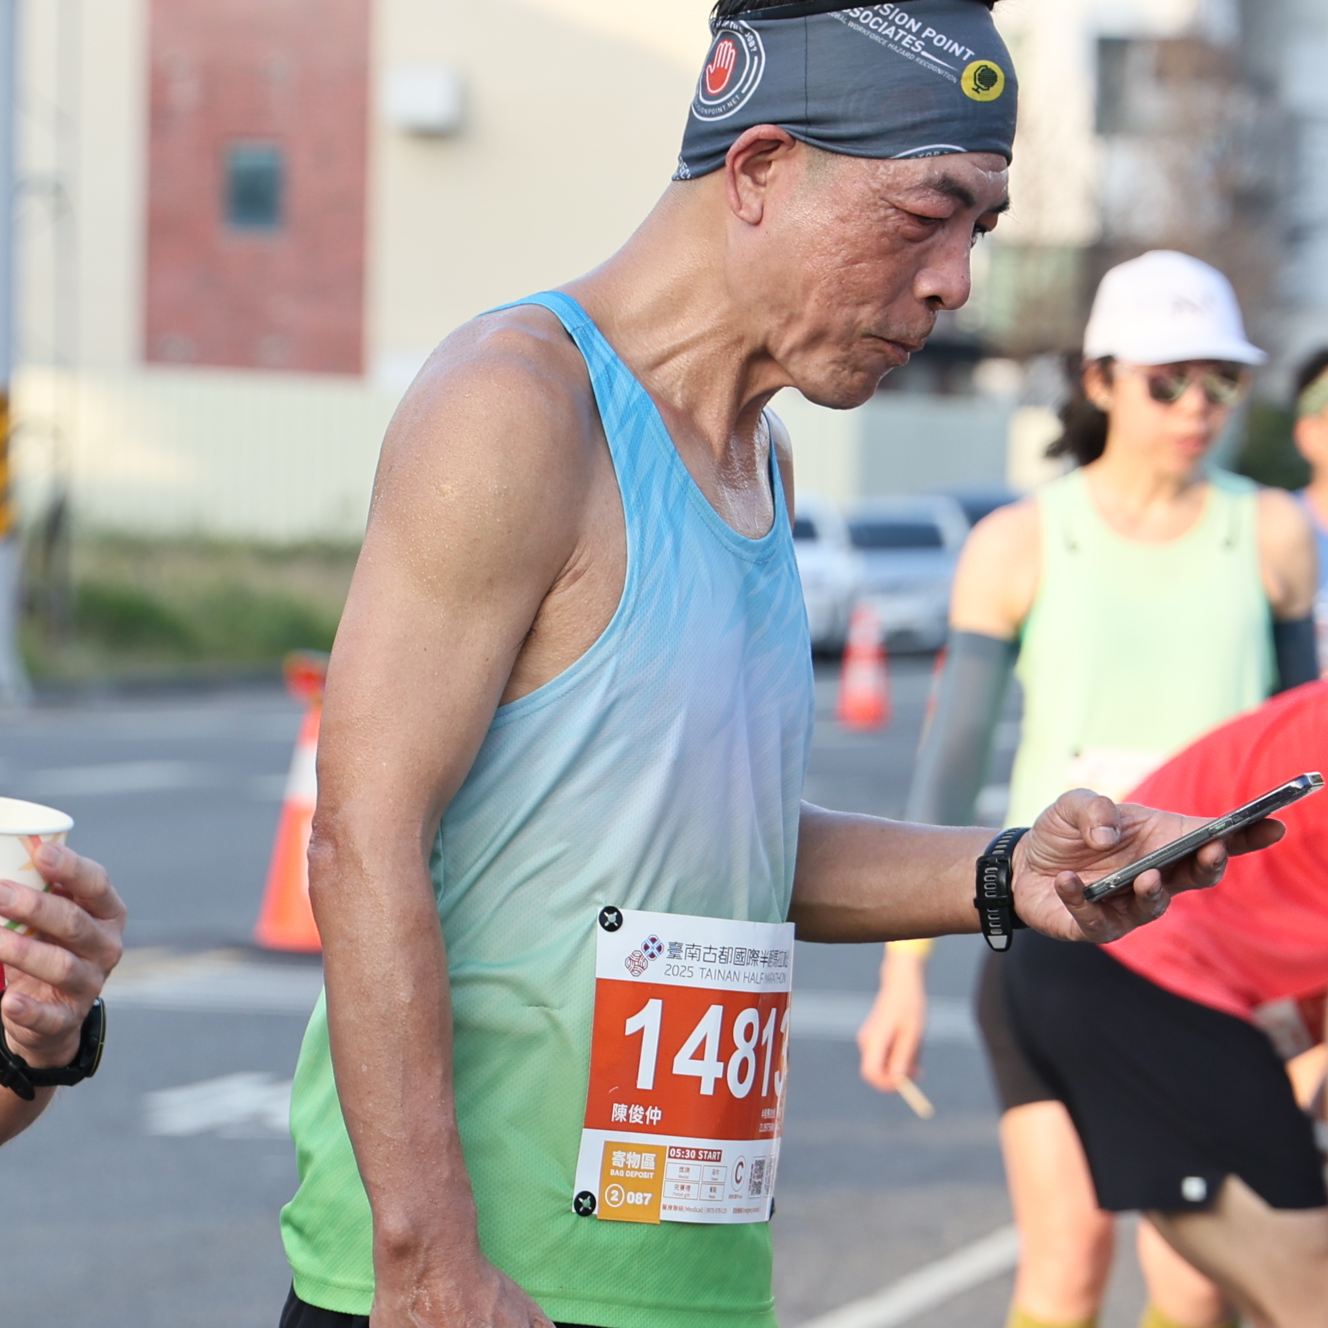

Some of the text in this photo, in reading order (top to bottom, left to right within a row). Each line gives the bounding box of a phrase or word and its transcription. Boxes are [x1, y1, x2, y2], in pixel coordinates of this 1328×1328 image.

[842, 7, 925, 53] SOCIATES
[744, 31, 758, 52] JOB?
[847, 20, 887, 47] WORKFORCE
[887, 43, 915, 60] HAZARD
[914, 57, 958, 84] RECOGNITION
[921, 27, 975, 61] POINT
[664, 963, 694, 978] 2025
[699, 967, 741, 982] TAINAN
[742, 971, 763, 984] HALF
[611, 1103, 662, 1126] 陳俊仲
[611, 1151, 657, 1170] 寄物區
[670, 1148, 721, 1160] 05:30 START
[610, 1169, 655, 1179] BAG DEPOSIT
[734, 1161, 744, 1184] C
[610, 1190, 653, 1205] 2 087
